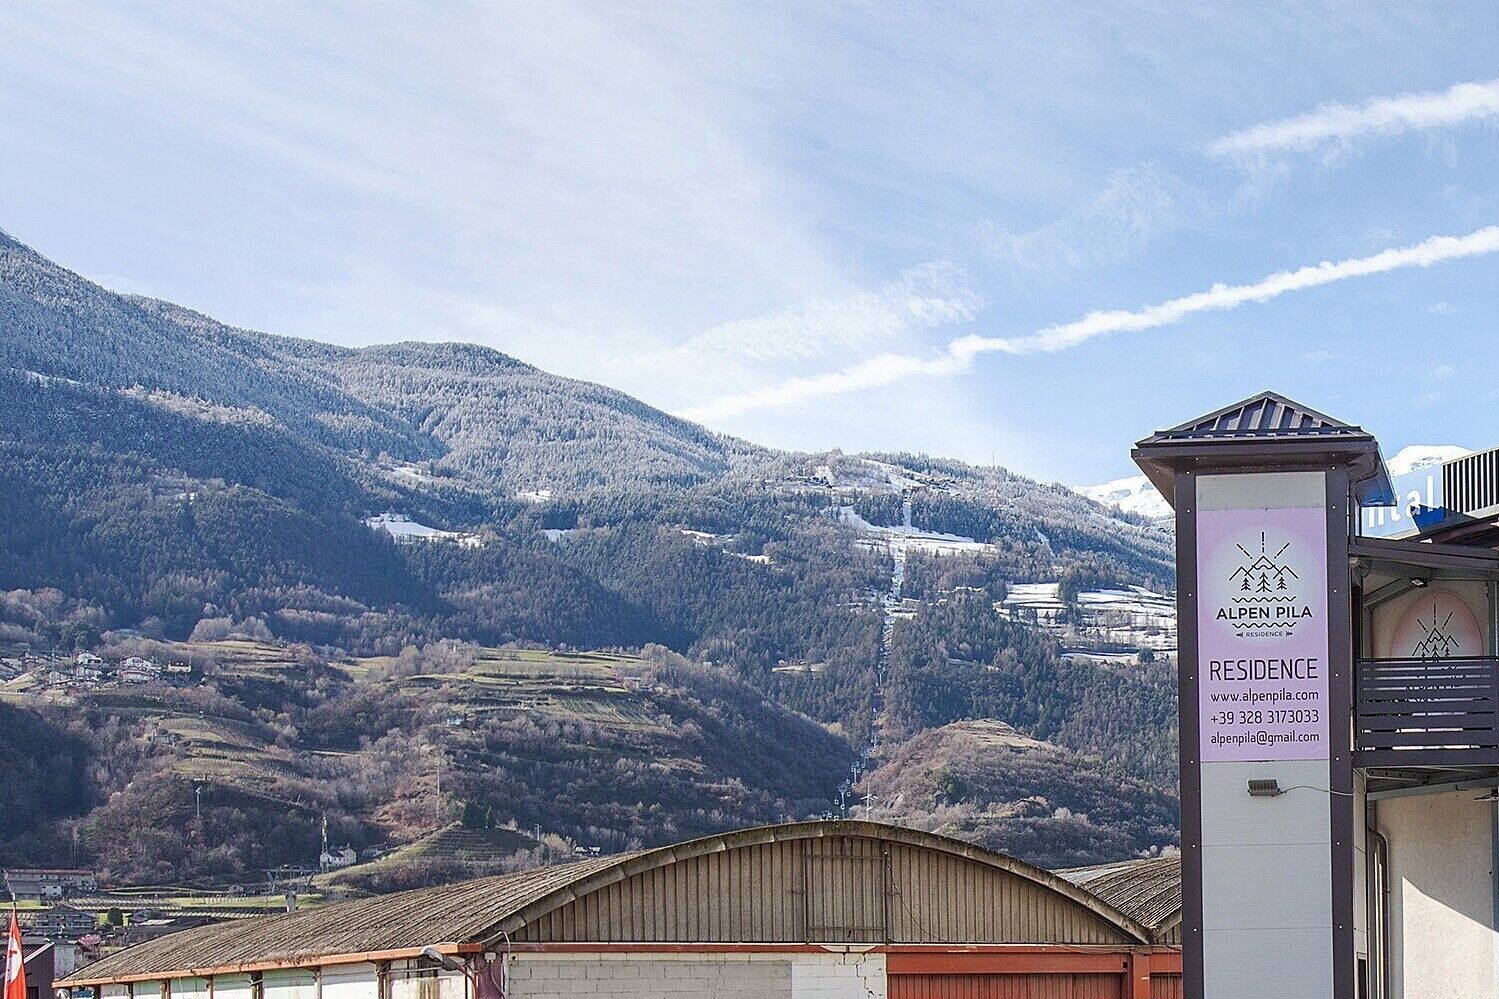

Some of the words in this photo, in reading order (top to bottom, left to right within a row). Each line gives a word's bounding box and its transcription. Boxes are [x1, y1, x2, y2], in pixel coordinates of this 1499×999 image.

[1216, 607, 1270, 620] ALPEN
[1276, 606, 1313, 619] PILA
[1209, 658, 1319, 681] RESIDENCE
[1210, 687, 1319, 705] www.alpenpila.com
[1210, 711, 1235, 725] +39
[1239, 710, 1263, 725] 328
[1267, 709, 1320, 724] 3173033
[1210, 730, 1320, 747] alpenpila@gmail.com
